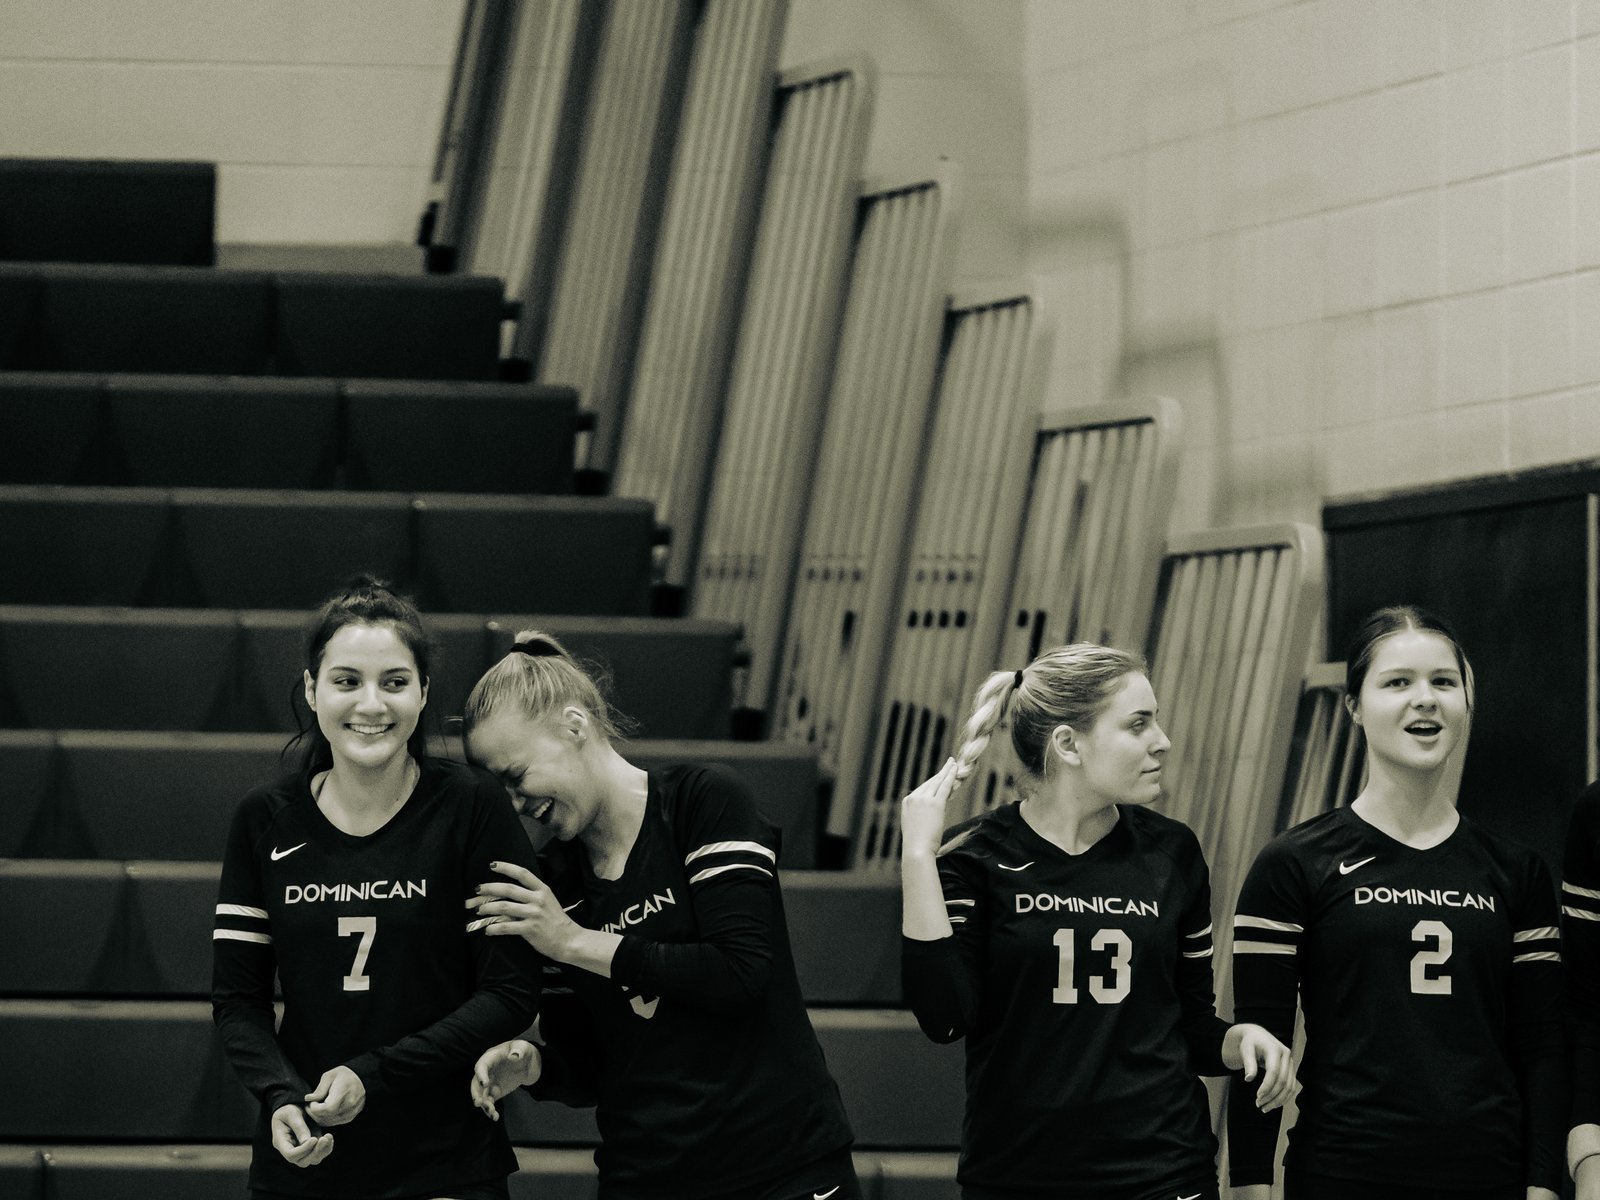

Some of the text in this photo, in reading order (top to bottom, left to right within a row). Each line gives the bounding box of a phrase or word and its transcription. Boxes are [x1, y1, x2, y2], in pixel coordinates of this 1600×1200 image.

[285, 879, 426, 904] DOMINICAN
[1015, 893, 1159, 917] DOMINICAN
[1354, 887, 1495, 912] DOMINICAN
[338, 916, 377, 991] 7
[1053, 928, 1132, 1004] 13
[1410, 920, 1453, 995] 2
